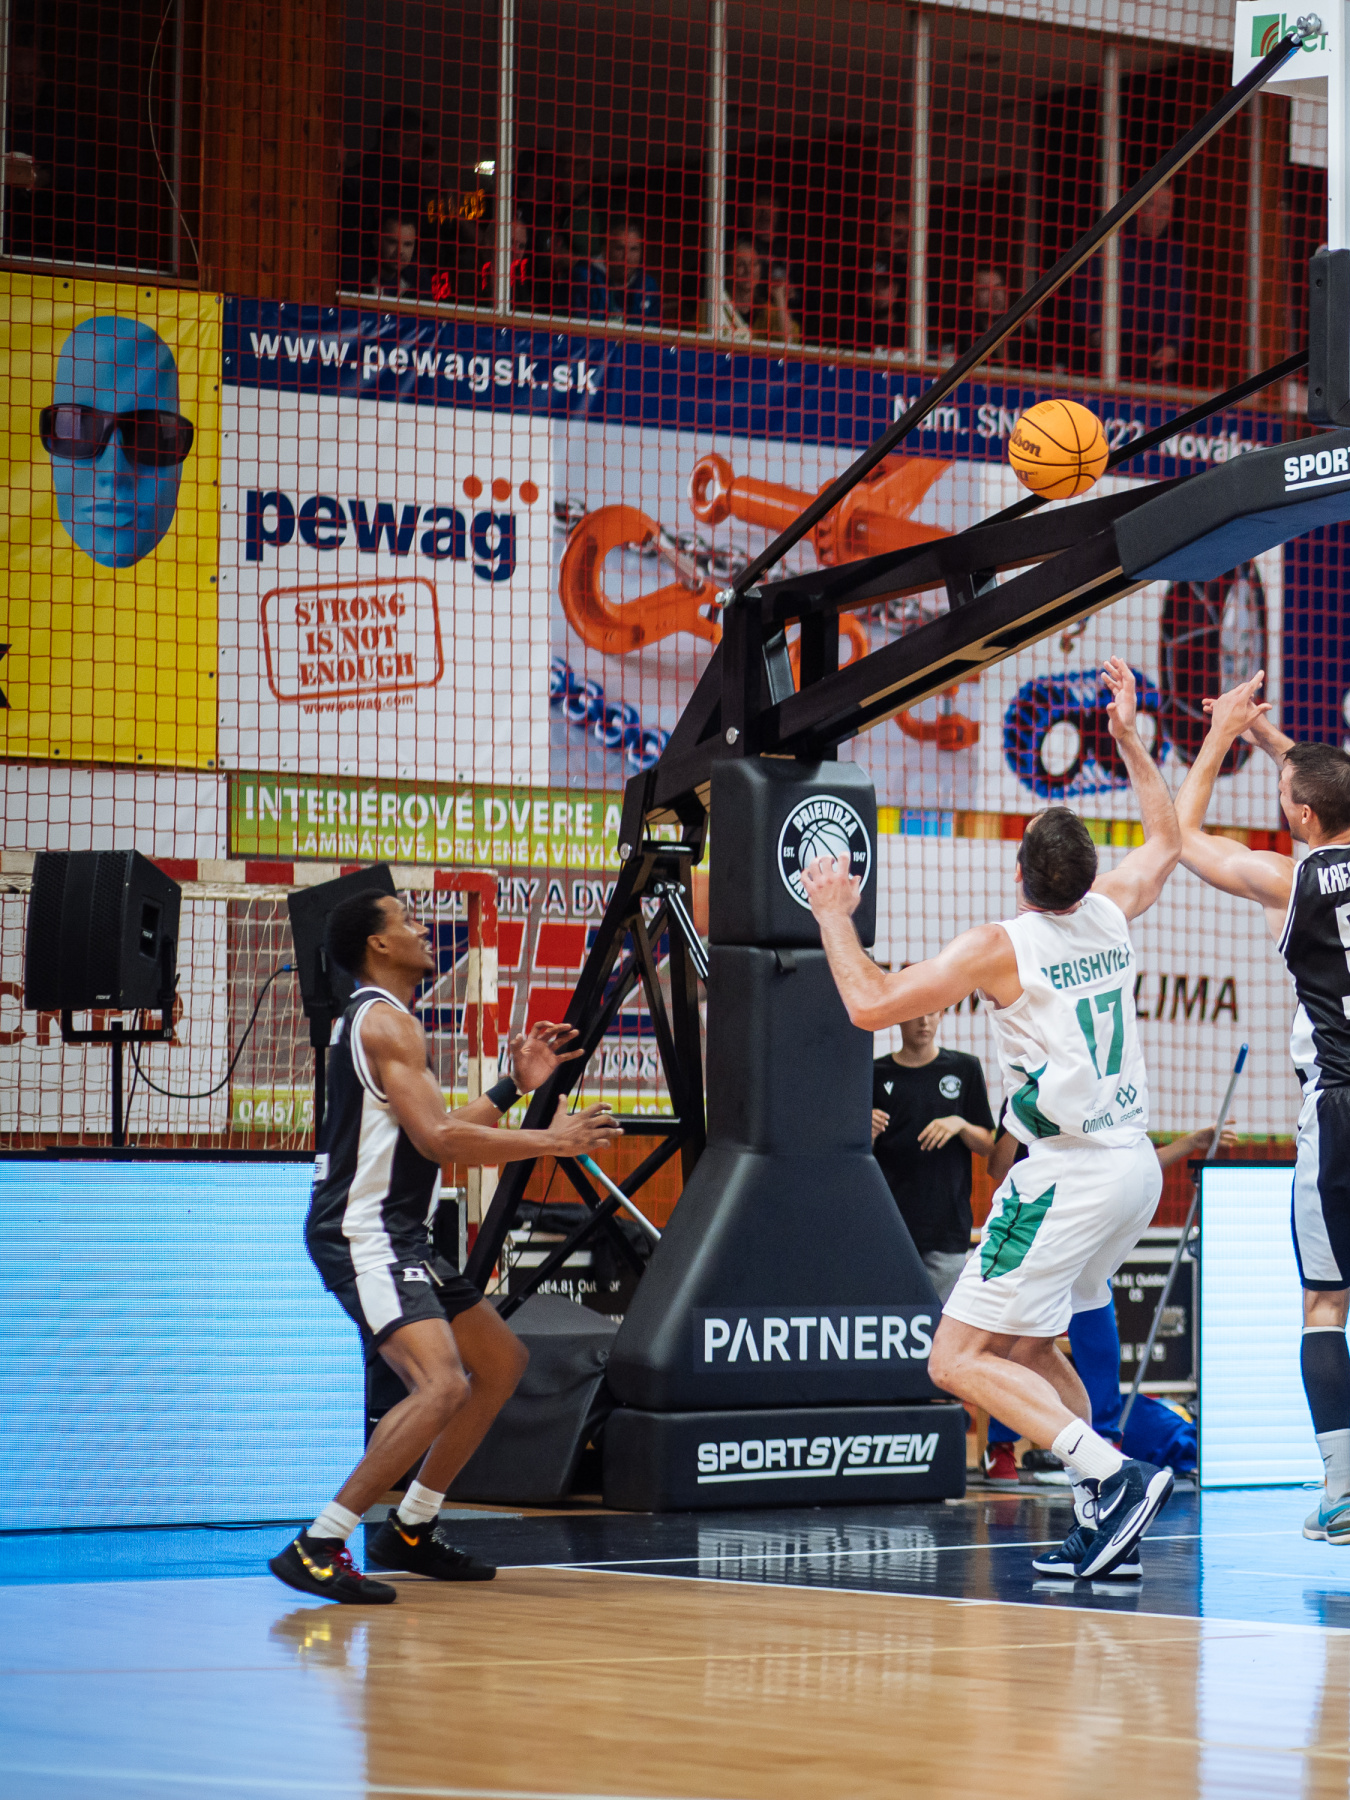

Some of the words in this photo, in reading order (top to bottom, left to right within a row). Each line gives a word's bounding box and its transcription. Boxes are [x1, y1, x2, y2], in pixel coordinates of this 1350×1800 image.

[250, 329, 599, 395] www.pewagsk.sk
[245, 488, 517, 581] pewag
[295, 592, 406, 626] STRONG
[306, 630, 334, 656] IS
[341, 624, 397, 653] NOT
[300, 652, 414, 687] ENOUGH
[303, 694, 413, 715] www.pewag.com
[245, 785, 473, 831] INTERIÉROVÉ
[484, 799, 594, 837] DVERE
[792, 802, 858, 837] PRIEVIDZA
[292, 829, 430, 862] LAMINÁTOVÉ,
[436, 836, 528, 861] DREVENÉ
[533, 844, 546, 861] A
[783, 846, 795, 858] EST.
[853, 851, 866, 862] 1947
[1136, 973, 1238, 1022] LIMA
[1075, 987, 1124, 1080] 17
[704, 1314, 933, 1363] PARTNERS
[697, 1432, 939, 1476] SPORTSYSTEM
